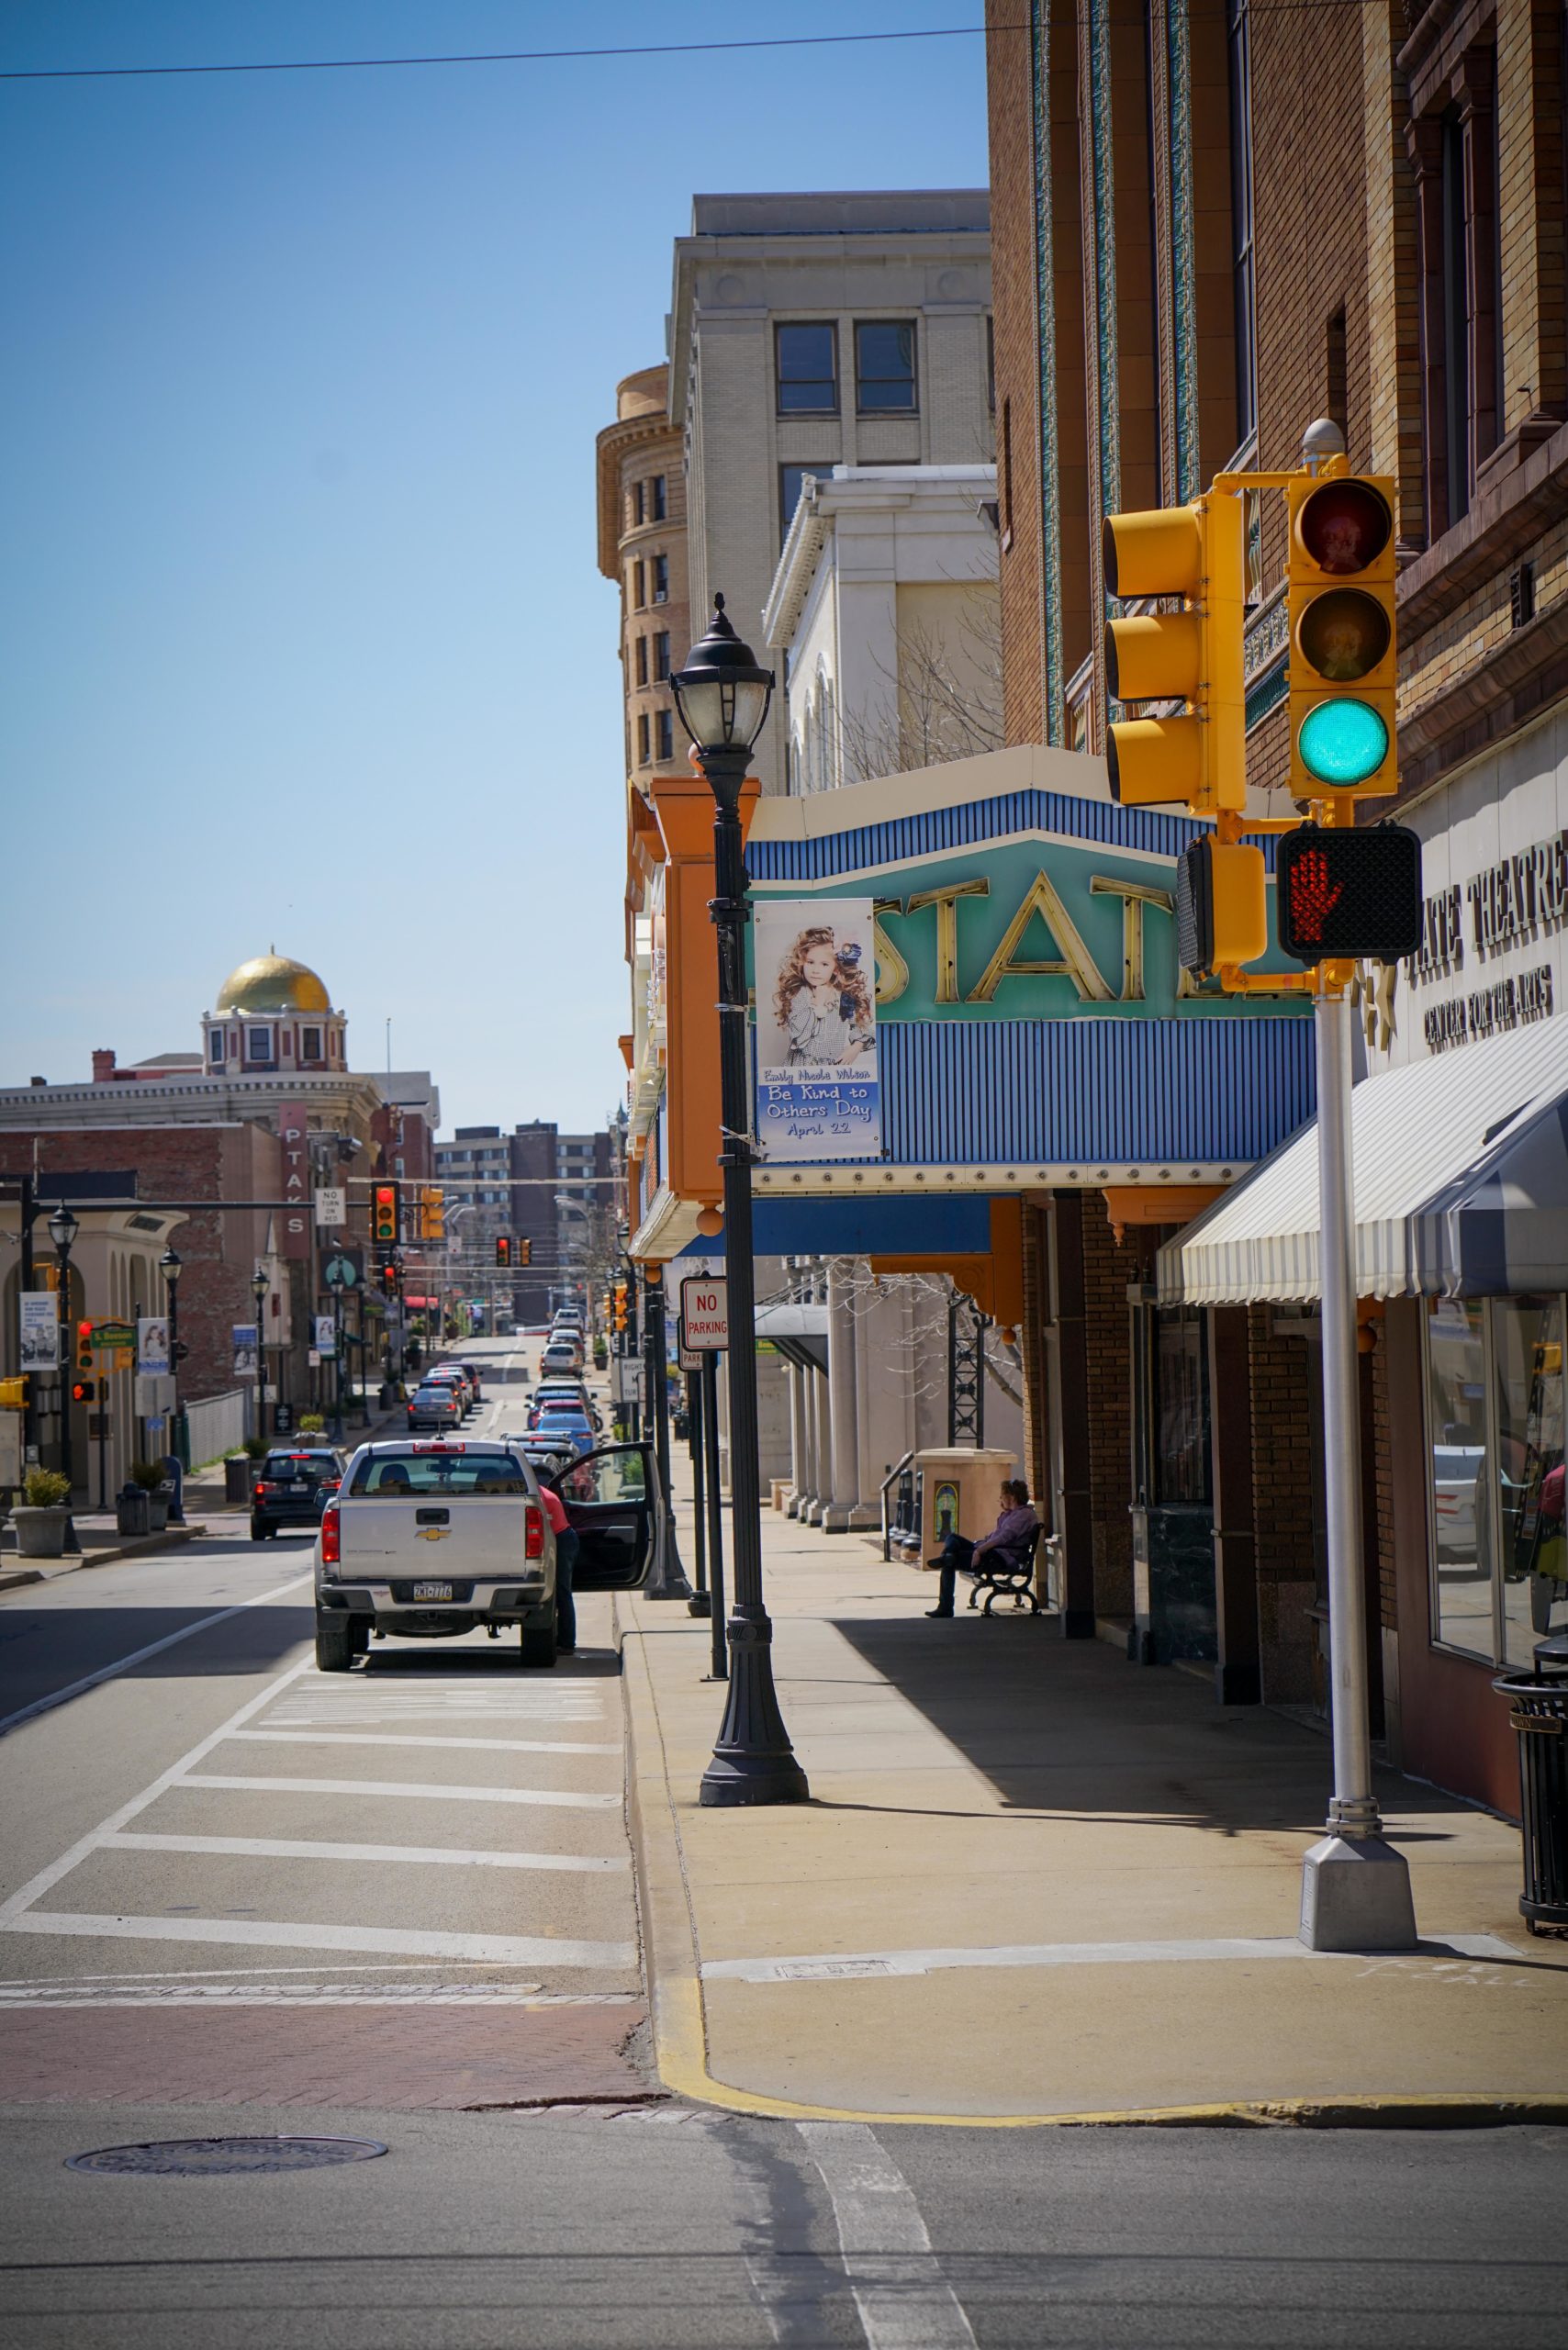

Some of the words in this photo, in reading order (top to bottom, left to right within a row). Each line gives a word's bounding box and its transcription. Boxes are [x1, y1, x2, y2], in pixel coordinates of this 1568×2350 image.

[1404, 885, 1462, 980] ATE
[1466, 830, 1568, 952] THEATRE
[873, 868, 1235, 1004] TAT
[1425, 998, 1466, 1046] CENTER
[1467, 990, 1492, 1031] FOR
[1492, 979, 1515, 1023] THE
[1515, 965, 1552, 1014] ARTS
[765, 1069, 793, 1084] Emily
[798, 1069, 831, 1081] Nicole
[835, 1069, 870, 1080] Wilson
[768, 1085, 792, 1102] Be
[801, 1085, 840, 1101] Kind
[849, 1088, 868, 1099] to
[767, 1103, 827, 1118] Others
[835, 1099, 871, 1123] Day
[788, 1124, 823, 1138] April
[831, 1123, 851, 1134] 22
[697, 1294, 717, 1312] NO
[689, 1321, 727, 1334] PARKING
[684, 1354, 703, 1362] PARK
